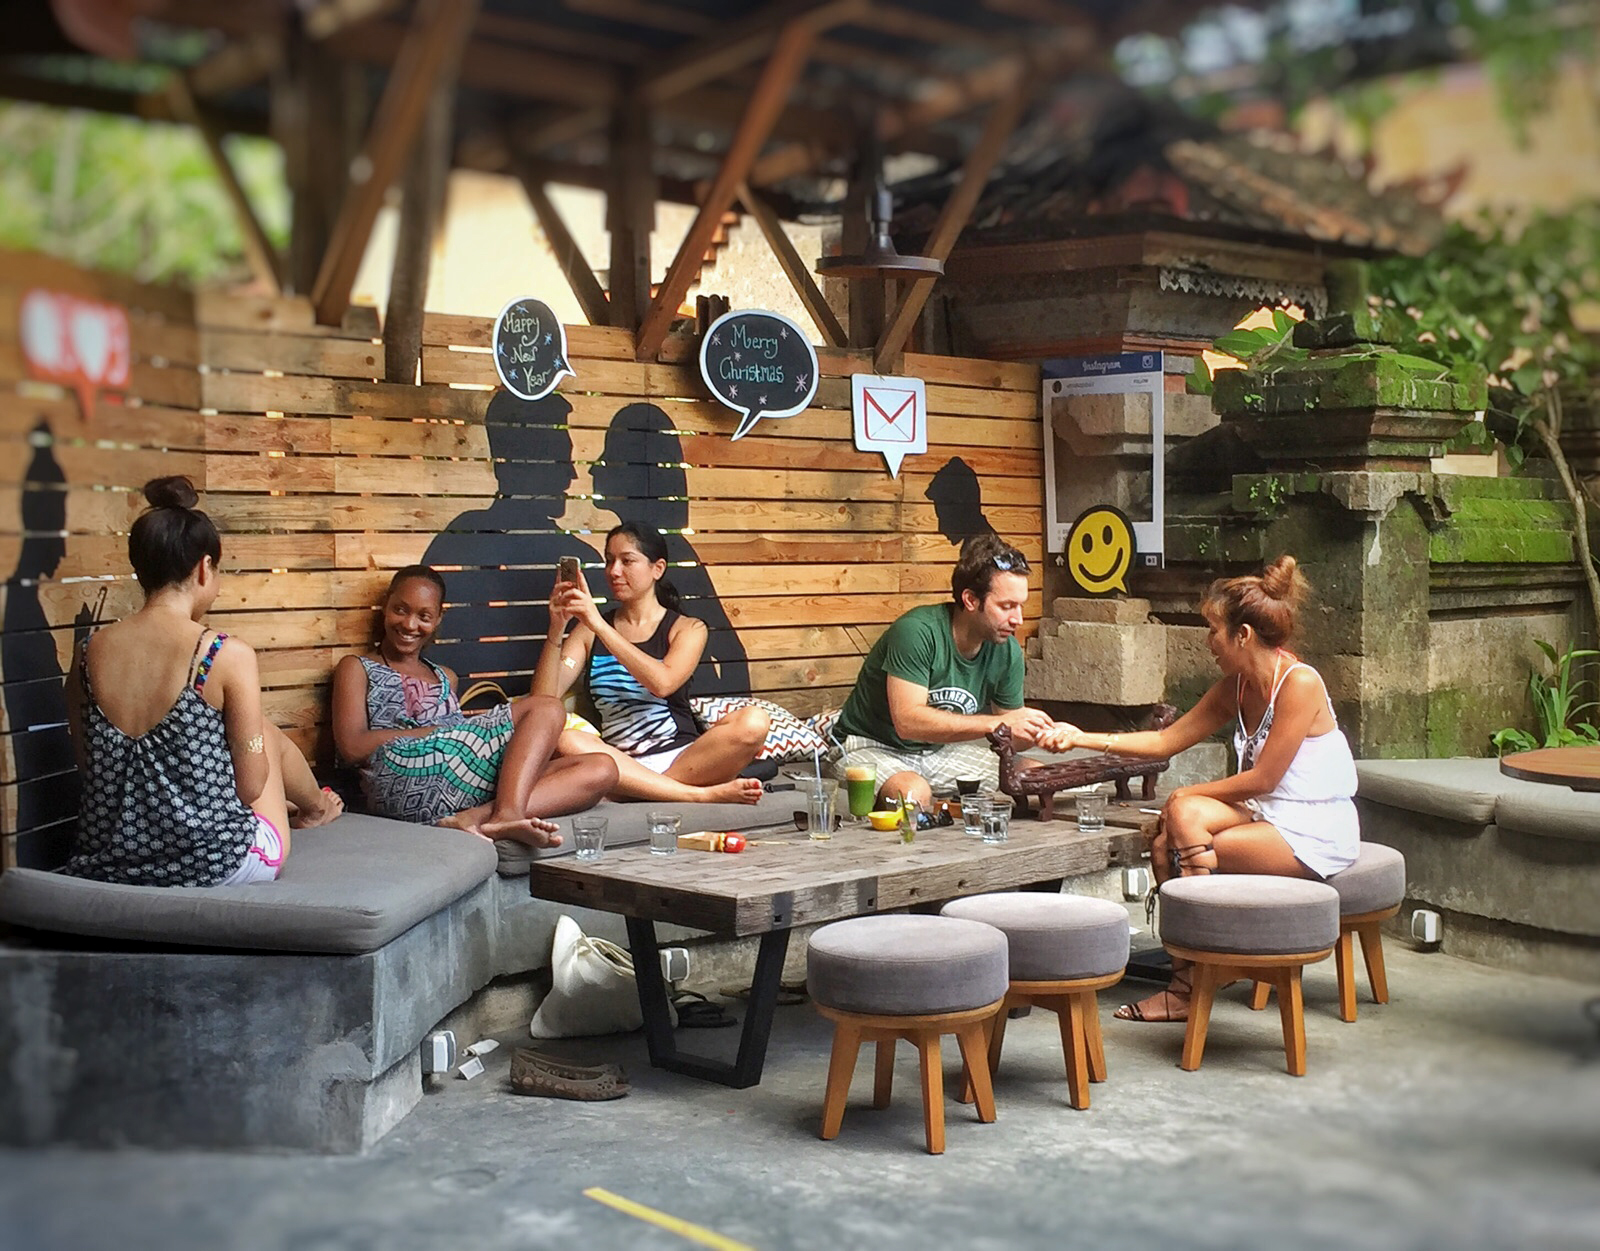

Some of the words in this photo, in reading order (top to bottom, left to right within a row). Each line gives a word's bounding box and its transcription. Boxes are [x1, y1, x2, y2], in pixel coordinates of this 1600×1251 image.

[503, 312, 540, 346] Happy
[731, 324, 778, 359] Merry
[510, 344, 538, 363] New
[1082, 360, 1121, 374] Instagram
[522, 366, 552, 393] Year
[719, 356, 784, 383] Christmas
[928, 690, 967, 704] ERLINER
